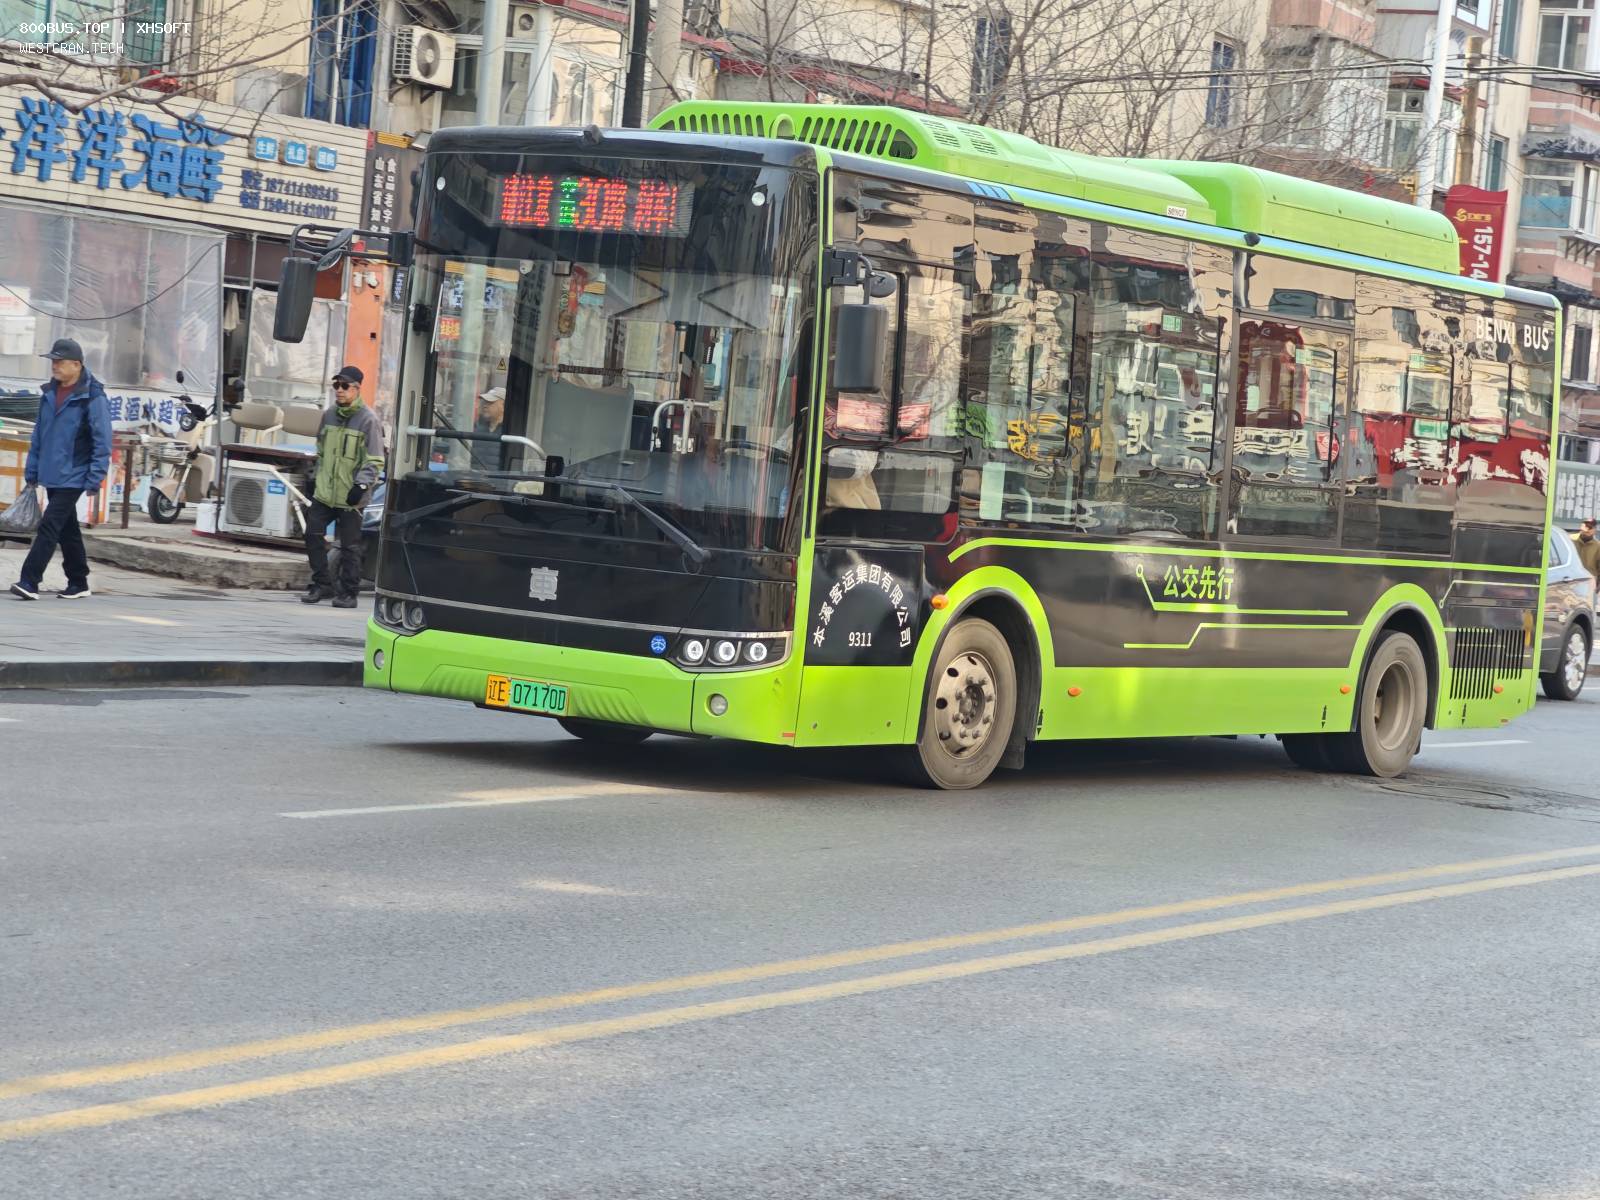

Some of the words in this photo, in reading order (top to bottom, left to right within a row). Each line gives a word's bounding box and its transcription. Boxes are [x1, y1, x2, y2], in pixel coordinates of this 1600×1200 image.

[0, 95, 234, 203] 洋洋海鲜
[1476, 315, 1516, 345] BENXI
[1523, 324, 1550, 351] BUS
[1163, 564, 1235, 601] 公交先行
[813, 564, 911, 648] 本溪客运集团有限公司
[848, 631, 872, 647] 9311
